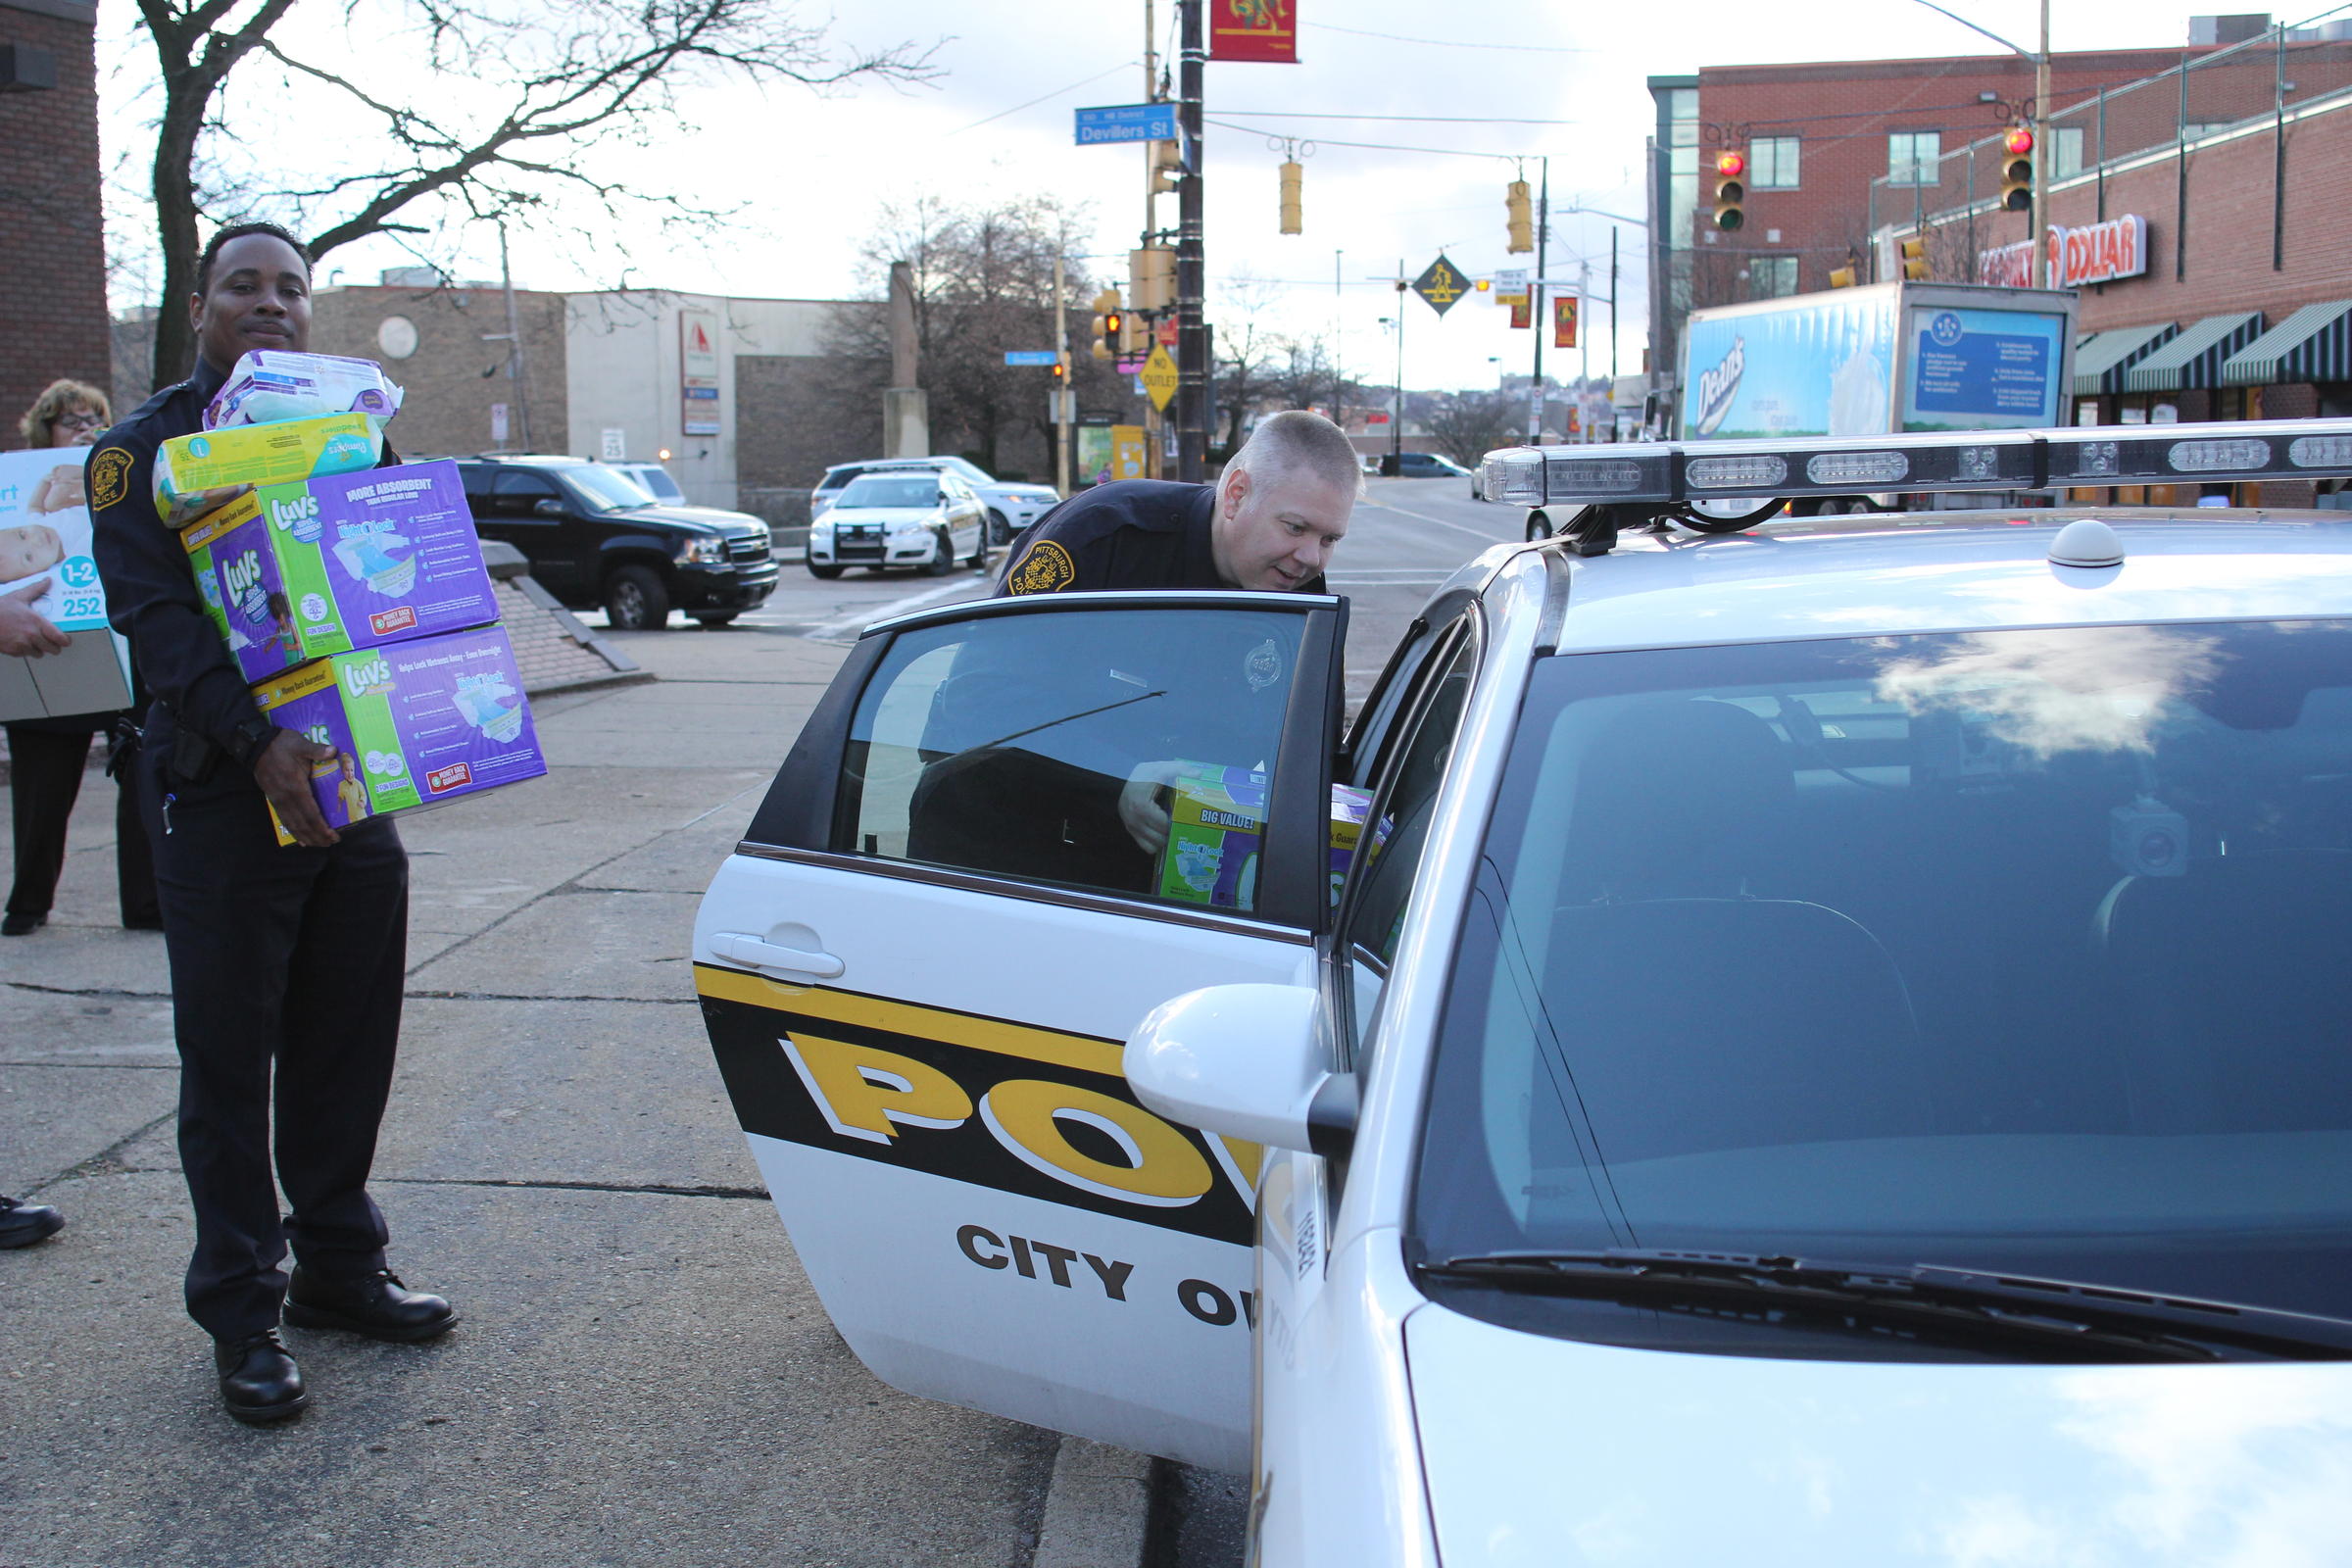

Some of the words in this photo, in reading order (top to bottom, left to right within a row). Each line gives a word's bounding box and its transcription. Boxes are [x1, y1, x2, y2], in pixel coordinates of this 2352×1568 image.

[1081, 124, 1145, 141] Devillers
[1151, 121, 1168, 136] St
[1153, 358, 1166, 369] NO
[1143, 374, 1176, 388] OUTLET
[607, 445, 621, 457] 25
[346, 485, 376, 502] MORE
[376, 478, 432, 495] ABSORBENT
[271, 496, 319, 531] Luvs
[337, 521, 363, 538] Night
[374, 517, 397, 533] Lock
[65, 563, 95, 582] 1-2
[1035, 546, 1069, 578] PITTSBURGH
[221, 549, 262, 609] Luvs
[63, 597, 101, 617] 252
[344, 660, 391, 698] Luvs
[1200, 808, 1218, 824] BIG
[1220, 811, 1255, 830] VALUE!
[956, 1224, 1134, 1302] CITY
[1177, 1278, 1256, 1331] O
